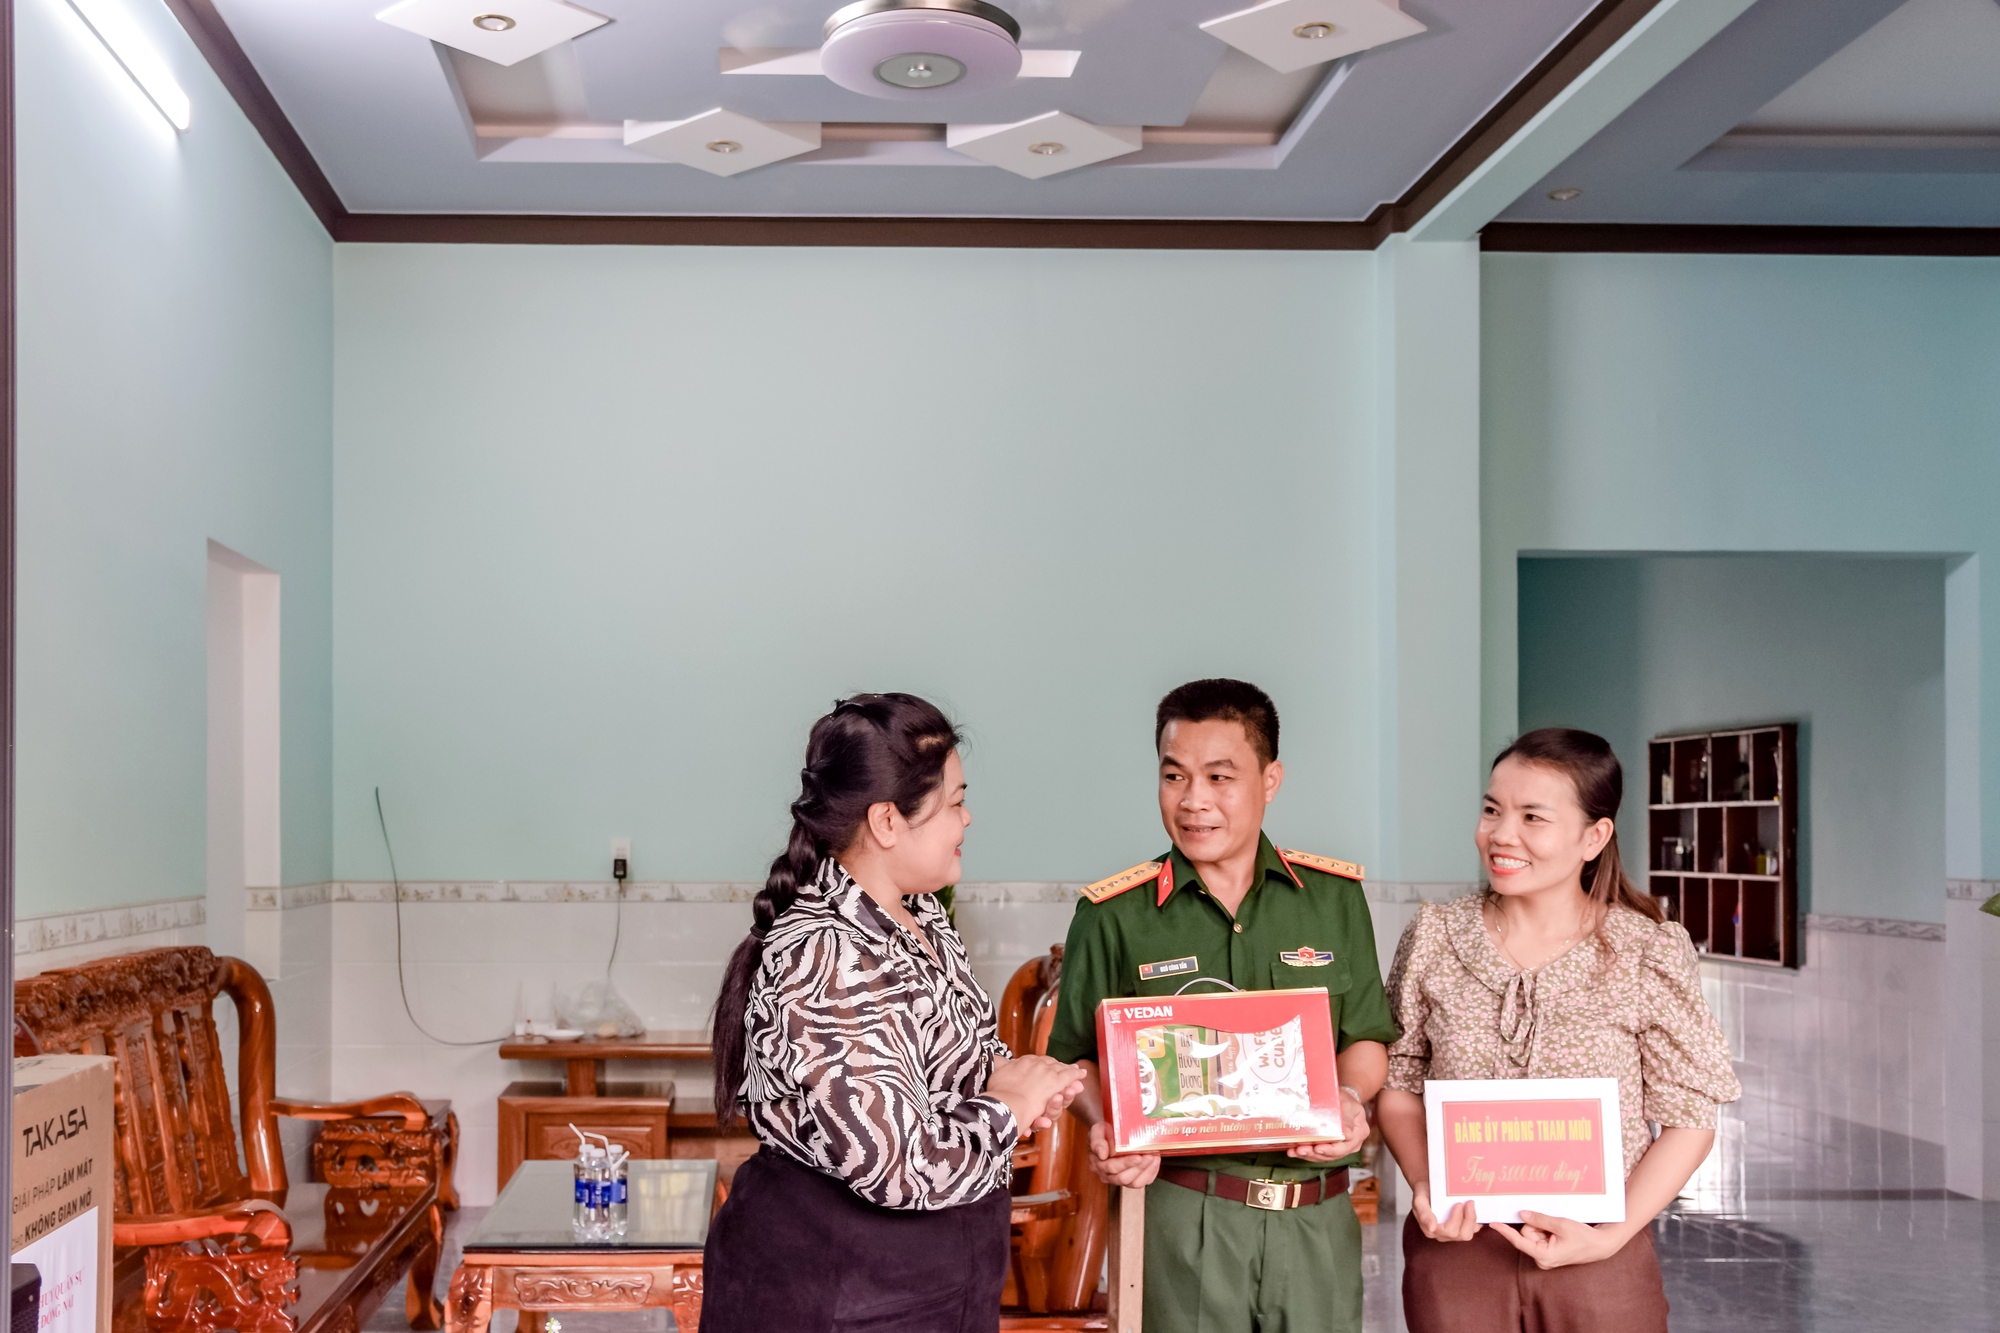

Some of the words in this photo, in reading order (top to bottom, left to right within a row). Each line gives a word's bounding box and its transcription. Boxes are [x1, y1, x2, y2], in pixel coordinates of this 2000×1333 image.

[1123, 1005, 1173, 1019] VEDAN
[22, 1105, 89, 1158] TAKASA
[1182, 1126, 1198, 1137] tạo
[1200, 1123, 1219, 1134] nên
[1254, 1120, 1263, 1133] vị
[1454, 1115, 1482, 1143] ĐẢNG
[1484, 1114, 1499, 1143] ỦY
[1501, 1116, 1535, 1142] PHÒNG
[1536, 1119, 1566, 1142] THAM
[1568, 1116, 1592, 1141] MƯU
[32, 1176, 56, 1205] PHÁP
[57, 1167, 75, 1191] LÀM
[76, 1156, 93, 1181] MÁT
[1461, 1155, 1496, 1193] Tặng
[1553, 1160, 1588, 1192] đồng!
[24, 1213, 56, 1243] KHÔNG
[57, 1198, 78, 1223] GIAN
